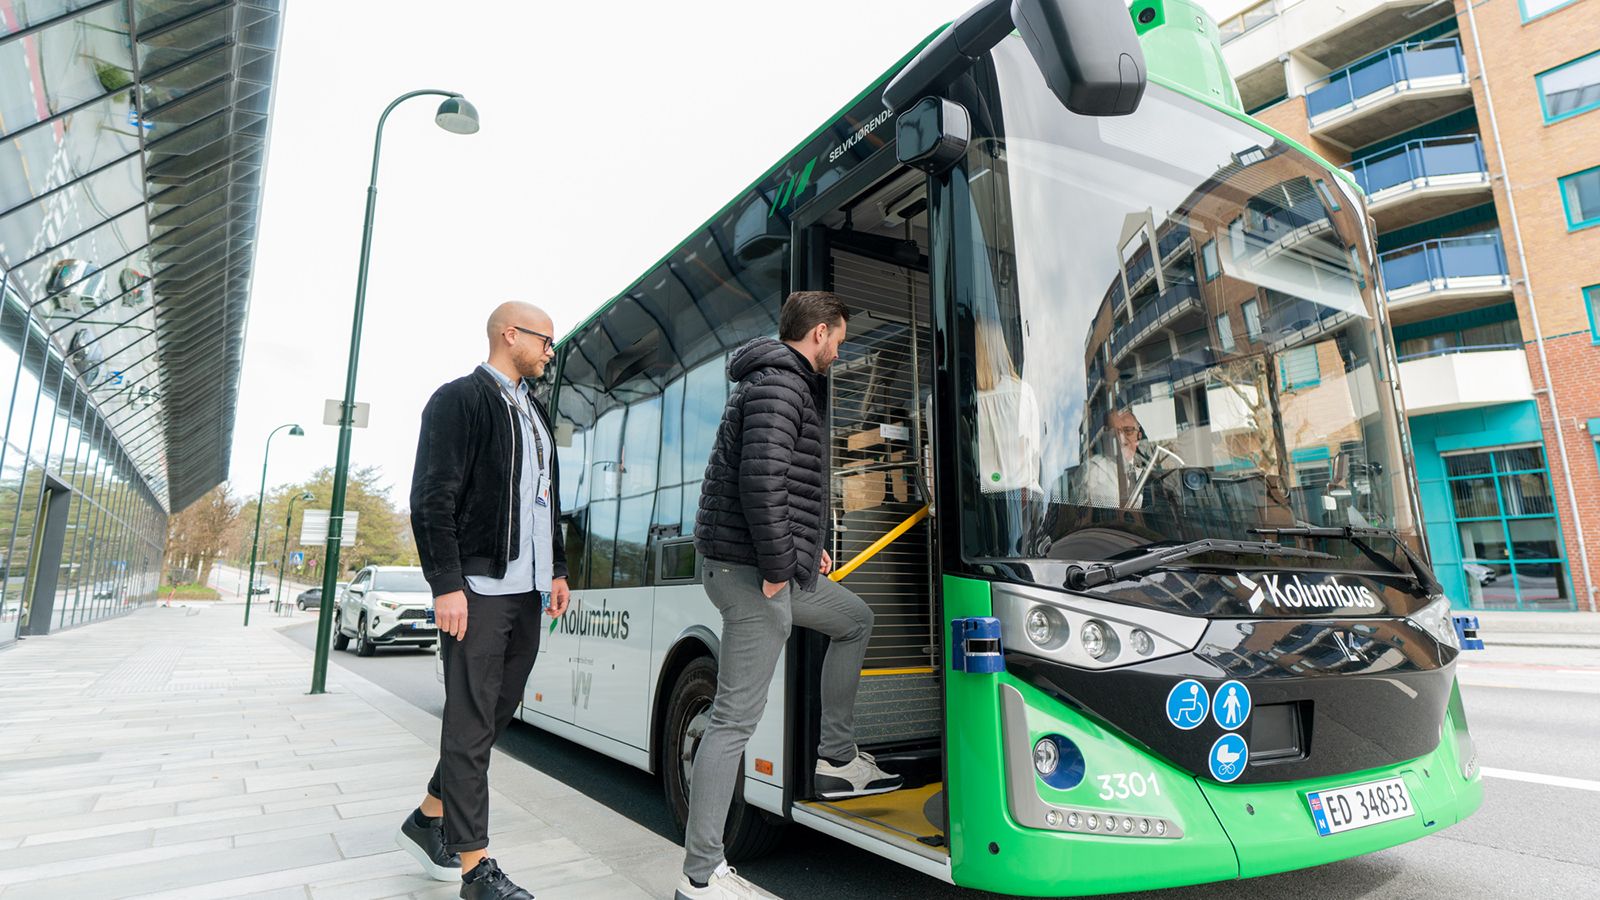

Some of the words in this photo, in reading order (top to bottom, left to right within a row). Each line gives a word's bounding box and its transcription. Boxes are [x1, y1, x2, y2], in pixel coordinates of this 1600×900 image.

[829, 108, 894, 163] SELVKJØRENDE
[1262, 574, 1376, 608] Kolumbus
[560, 598, 630, 640] Kolumbus
[1096, 771, 1160, 801] 3301
[1325, 794, 1353, 827] ED
[1355, 783, 1408, 820] 34853
[1318, 819, 1327, 830] N
